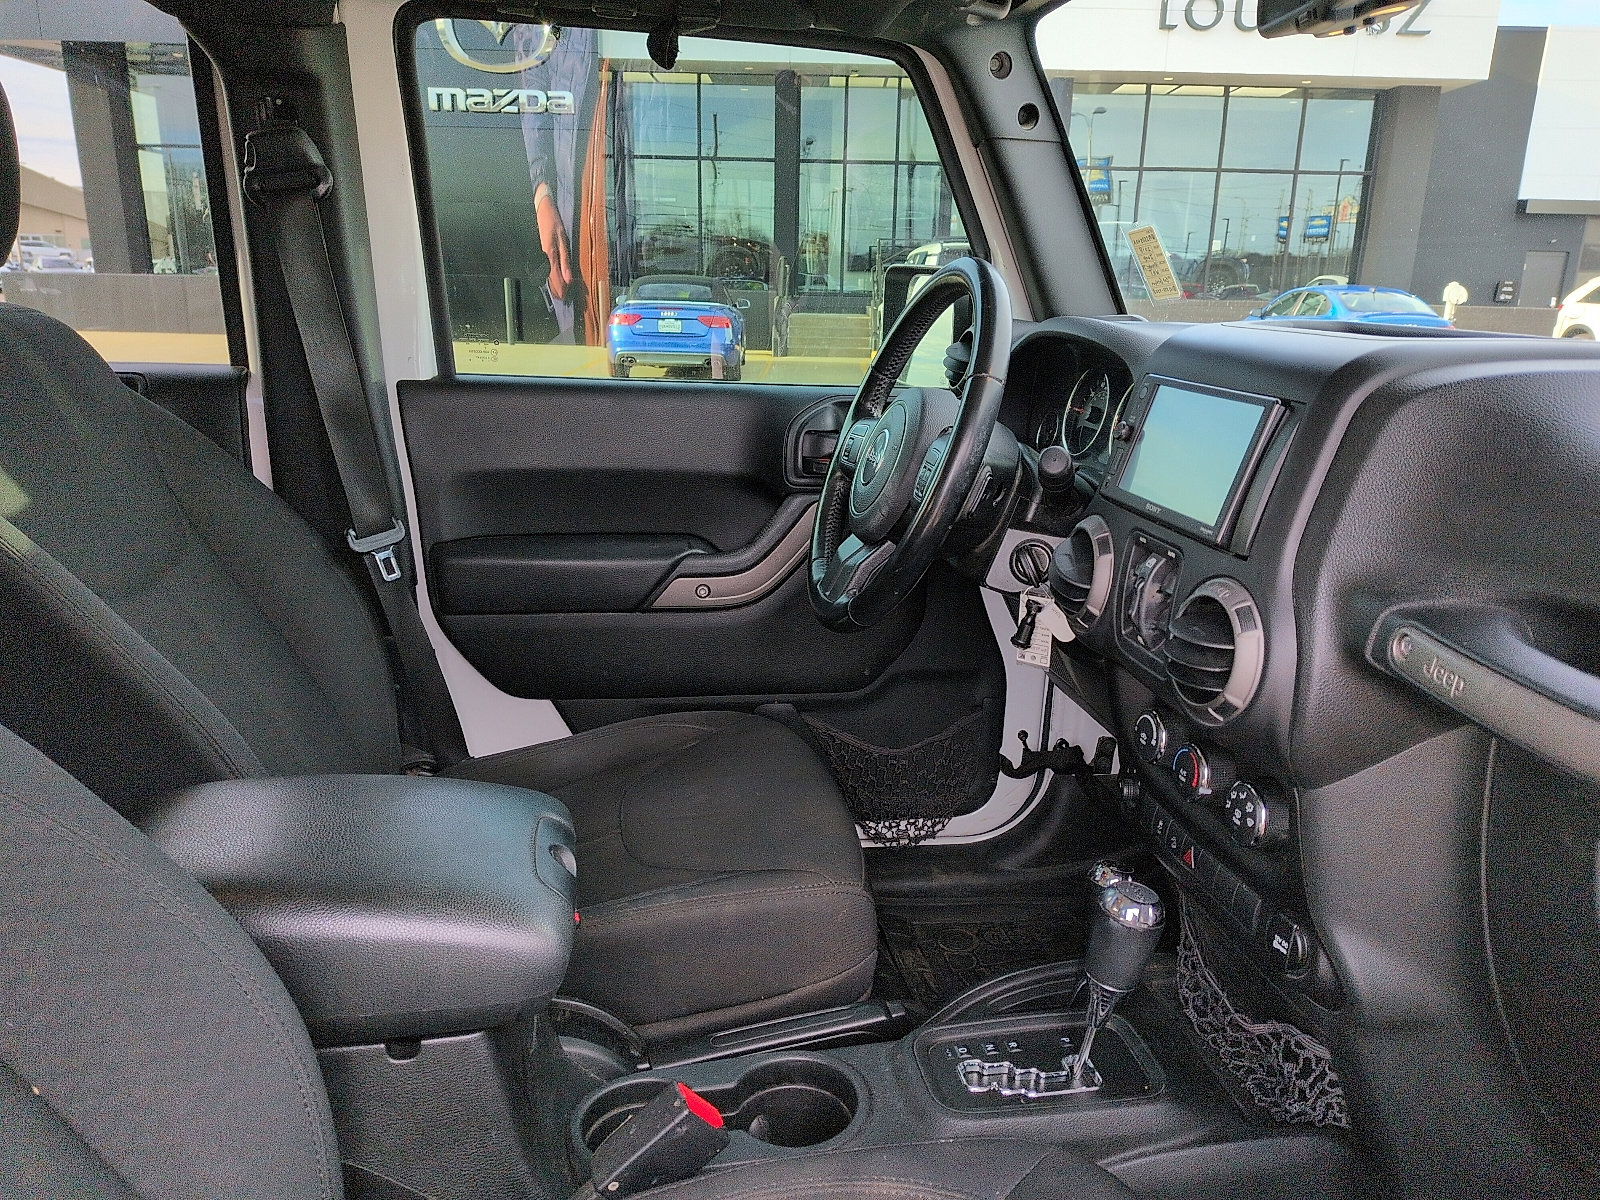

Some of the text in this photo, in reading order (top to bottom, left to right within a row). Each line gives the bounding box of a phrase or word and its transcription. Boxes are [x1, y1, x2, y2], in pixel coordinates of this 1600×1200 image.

[427, 86, 575, 115] mazda
[1146, 503, 1162, 514] SONY
[1422, 656, 1465, 699] Jeep
